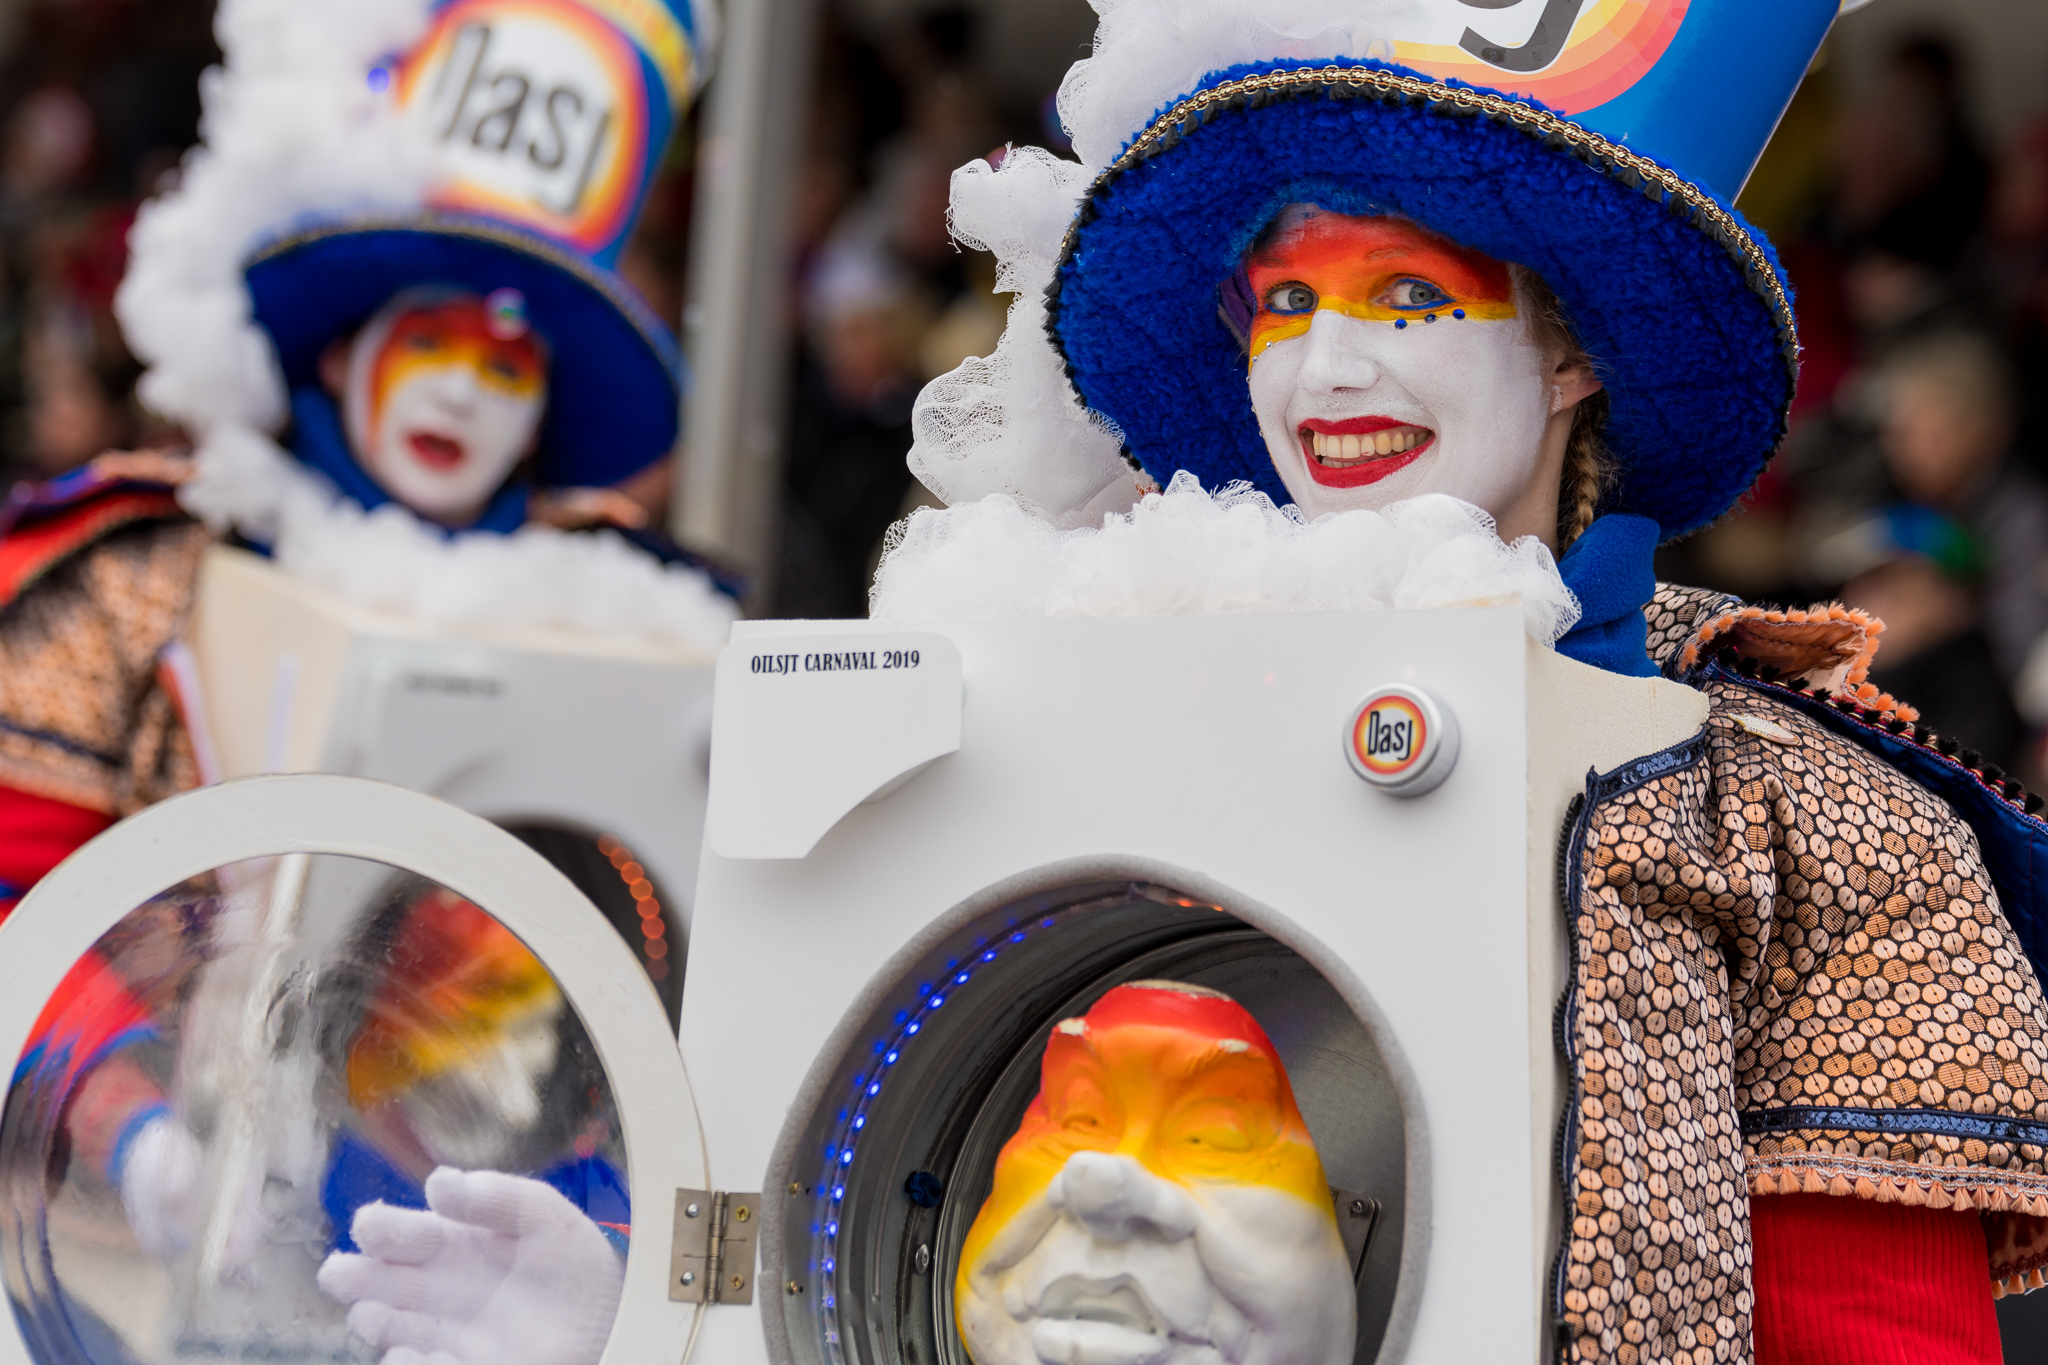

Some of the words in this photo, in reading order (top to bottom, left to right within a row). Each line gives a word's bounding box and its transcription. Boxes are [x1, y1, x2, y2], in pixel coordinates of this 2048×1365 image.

[751, 654, 799, 675] OILSJT
[804, 651, 878, 672] CARNAVAL
[883, 650, 920, 669] 2019
